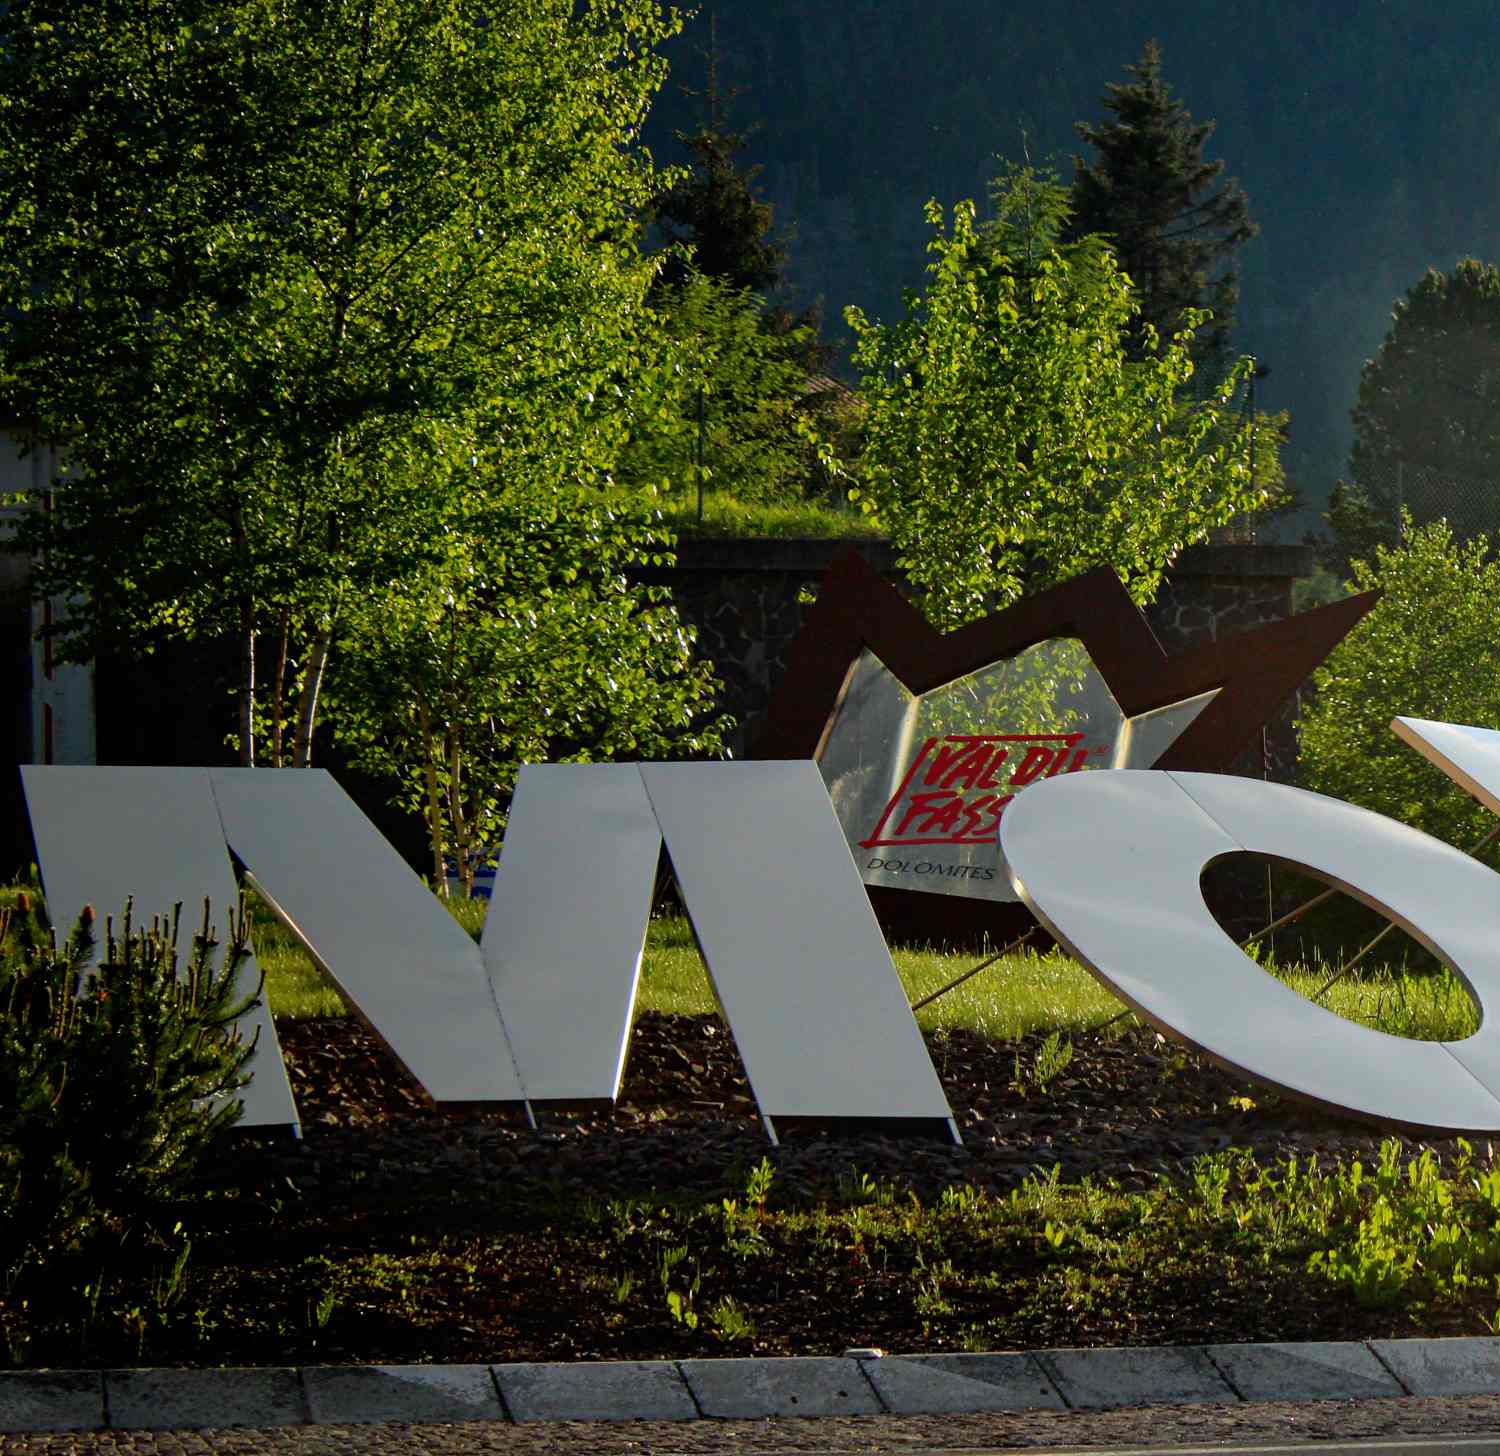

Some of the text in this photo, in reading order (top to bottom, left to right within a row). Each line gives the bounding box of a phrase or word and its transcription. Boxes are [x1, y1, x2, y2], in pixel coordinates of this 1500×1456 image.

[924, 740, 1010, 789] VAL
[895, 791, 1015, 837] FASS
[867, 857, 999, 881] DOLOMITES
